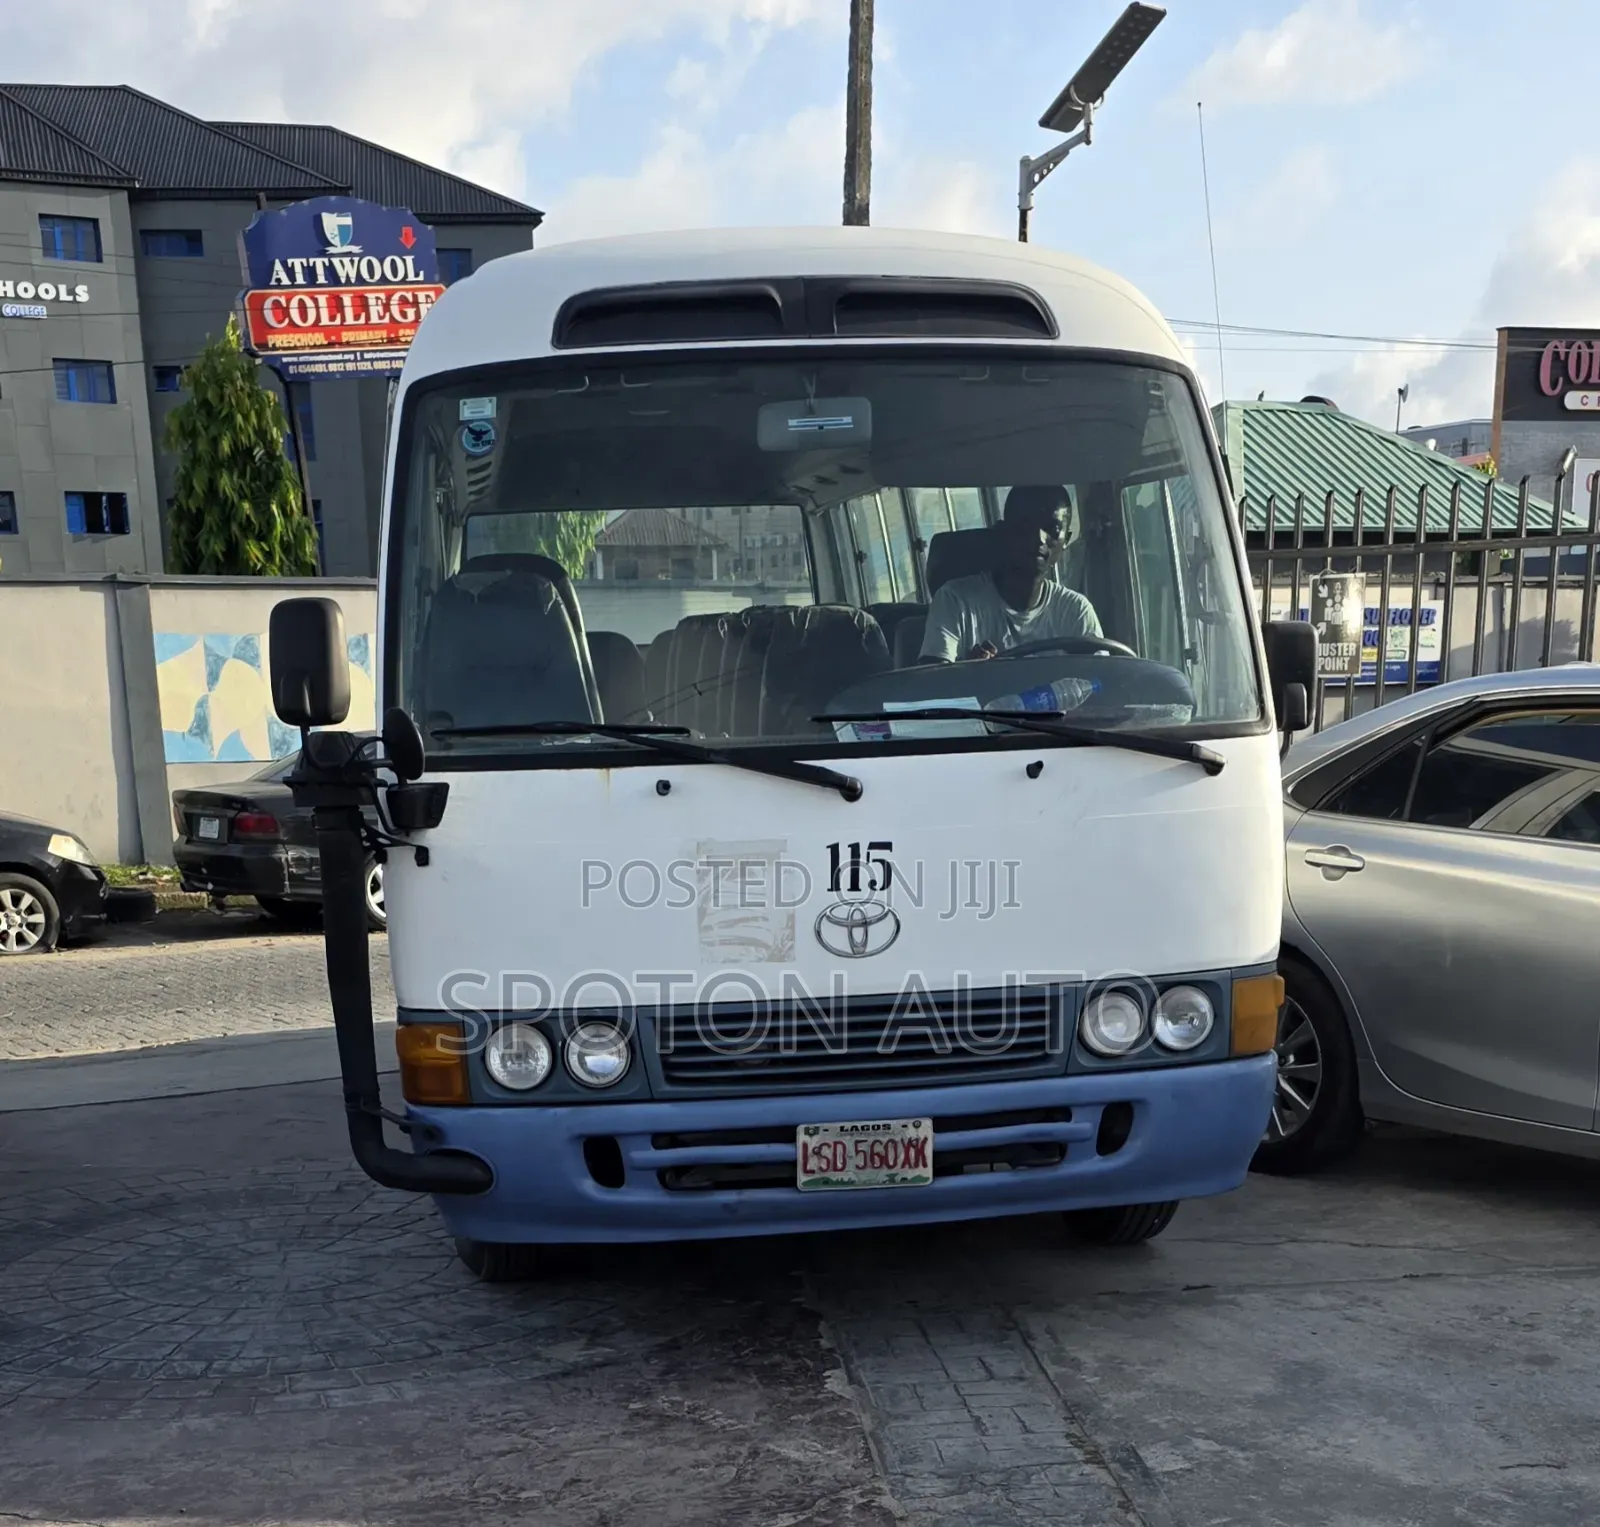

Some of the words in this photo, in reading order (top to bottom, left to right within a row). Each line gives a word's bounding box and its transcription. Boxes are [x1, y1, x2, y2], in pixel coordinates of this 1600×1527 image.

[269, 255, 424, 286] ATTWOOL
[0, 280, 90, 302] HOOLS
[4, 304, 46, 317] COLLEGE
[267, 332, 328, 348] PRESCHOOL
[1364, 607, 1437, 626] SUFLOER
[1318, 657, 1351, 671] POINT
[826, 841, 893, 893] 115
[839, 1123, 892, 1133] LAGOS
